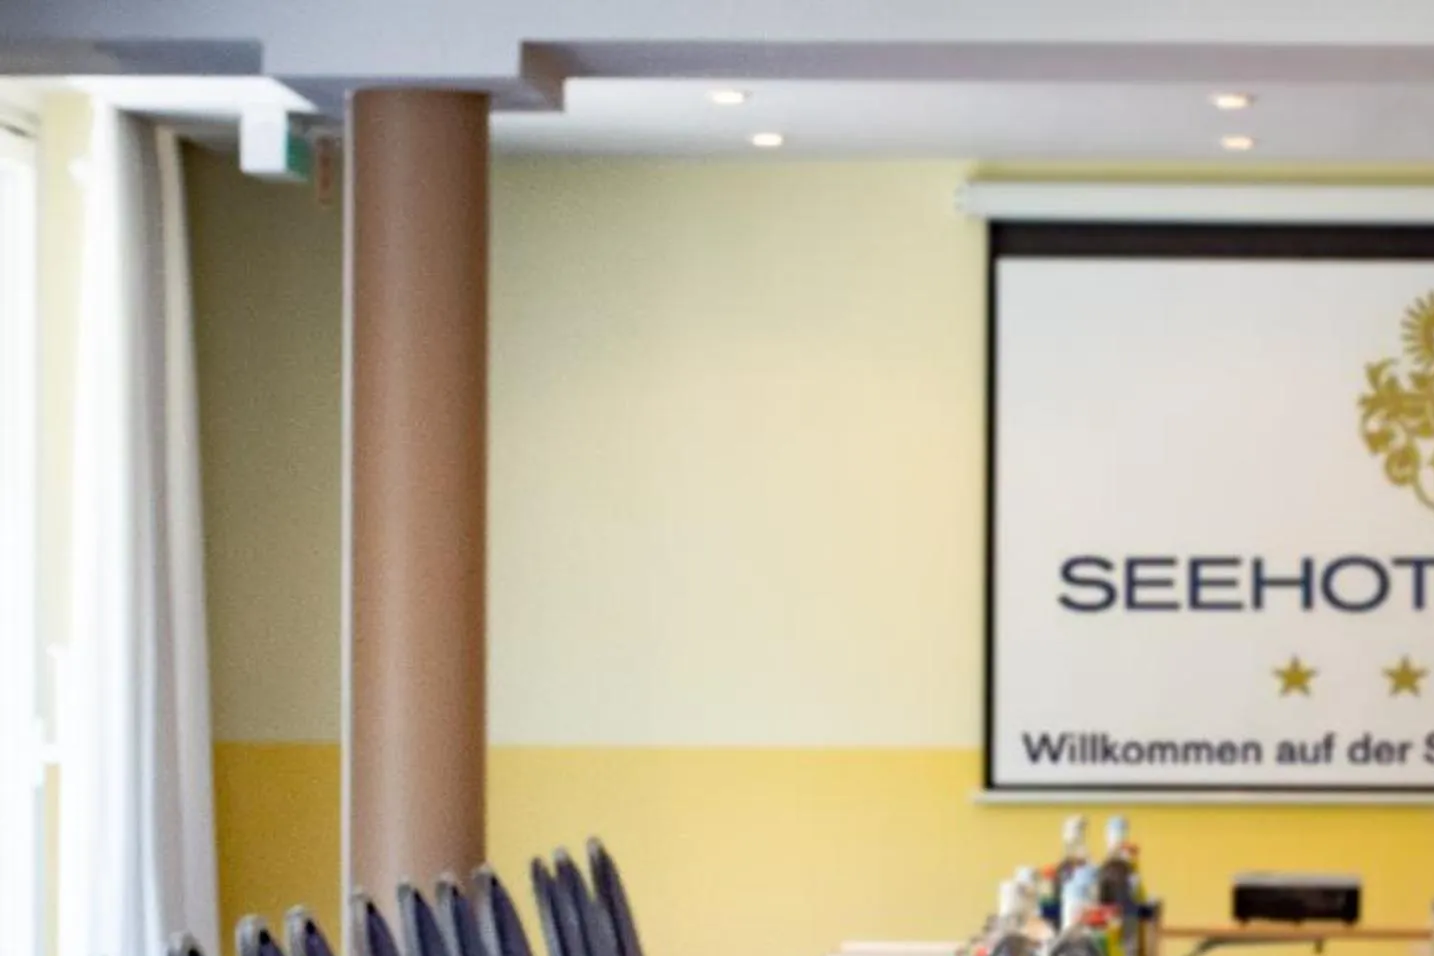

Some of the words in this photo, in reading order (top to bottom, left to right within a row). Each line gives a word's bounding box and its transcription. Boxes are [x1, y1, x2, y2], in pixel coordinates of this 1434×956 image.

[1022, 731, 1264, 766] Willkommen
[1275, 731, 1336, 766] auf
[1346, 731, 1414, 766] der
